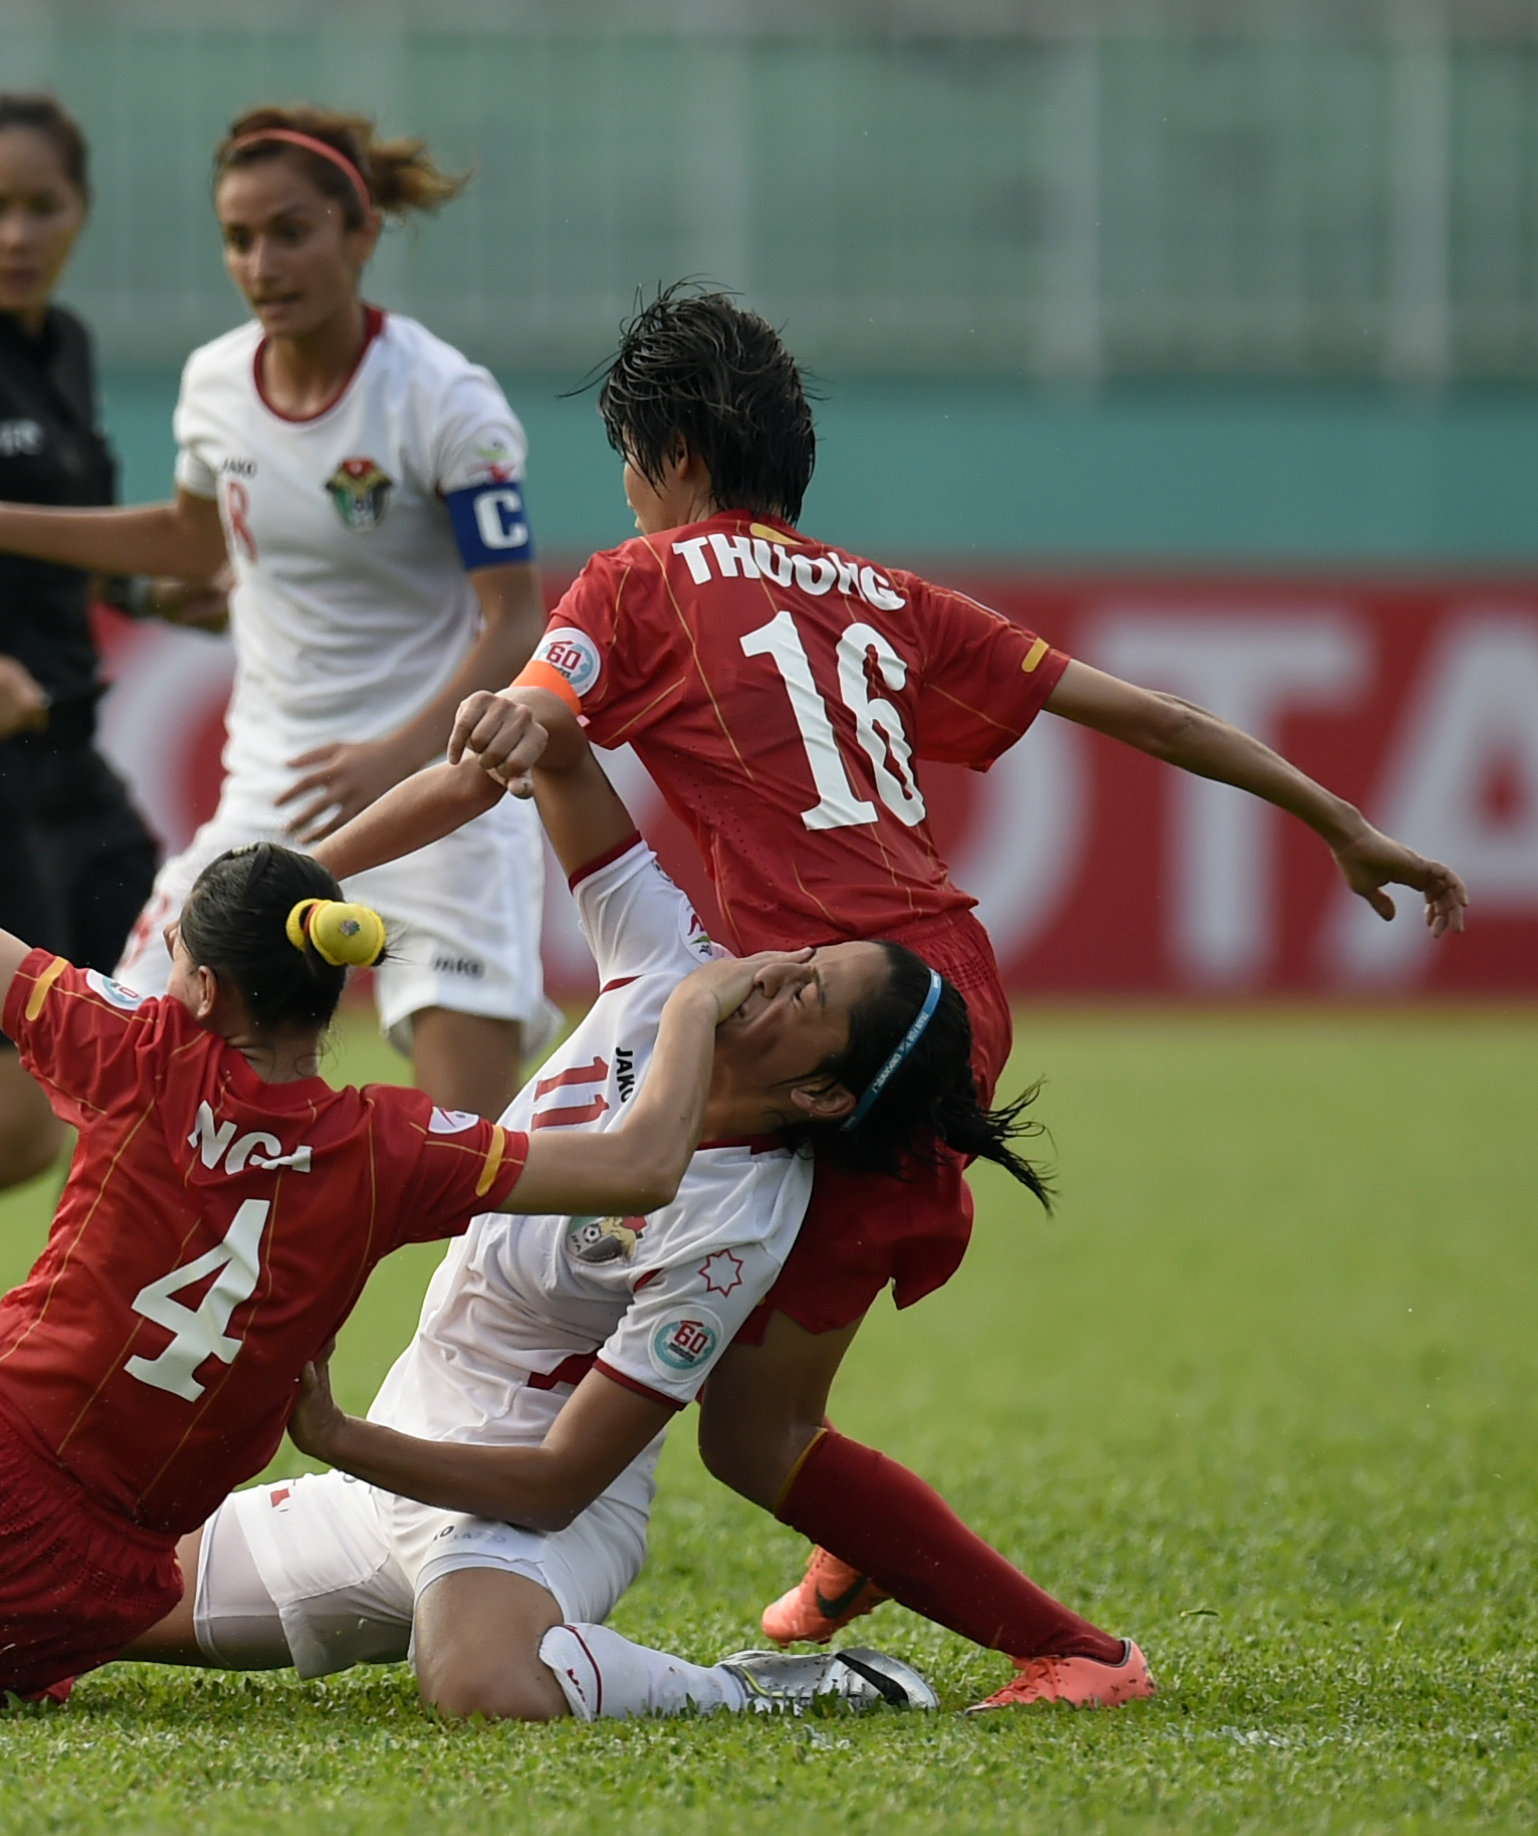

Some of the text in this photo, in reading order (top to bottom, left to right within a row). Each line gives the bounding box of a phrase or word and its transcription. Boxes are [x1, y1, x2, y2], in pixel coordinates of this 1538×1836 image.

[473, 490, 529, 550] C
[546, 644, 582, 671] 60
[739, 610, 926, 830] 16
[531, 1056, 610, 1132] 11
[123, 1199, 270, 1403] 4
[674, 1323, 709, 1355] 60
